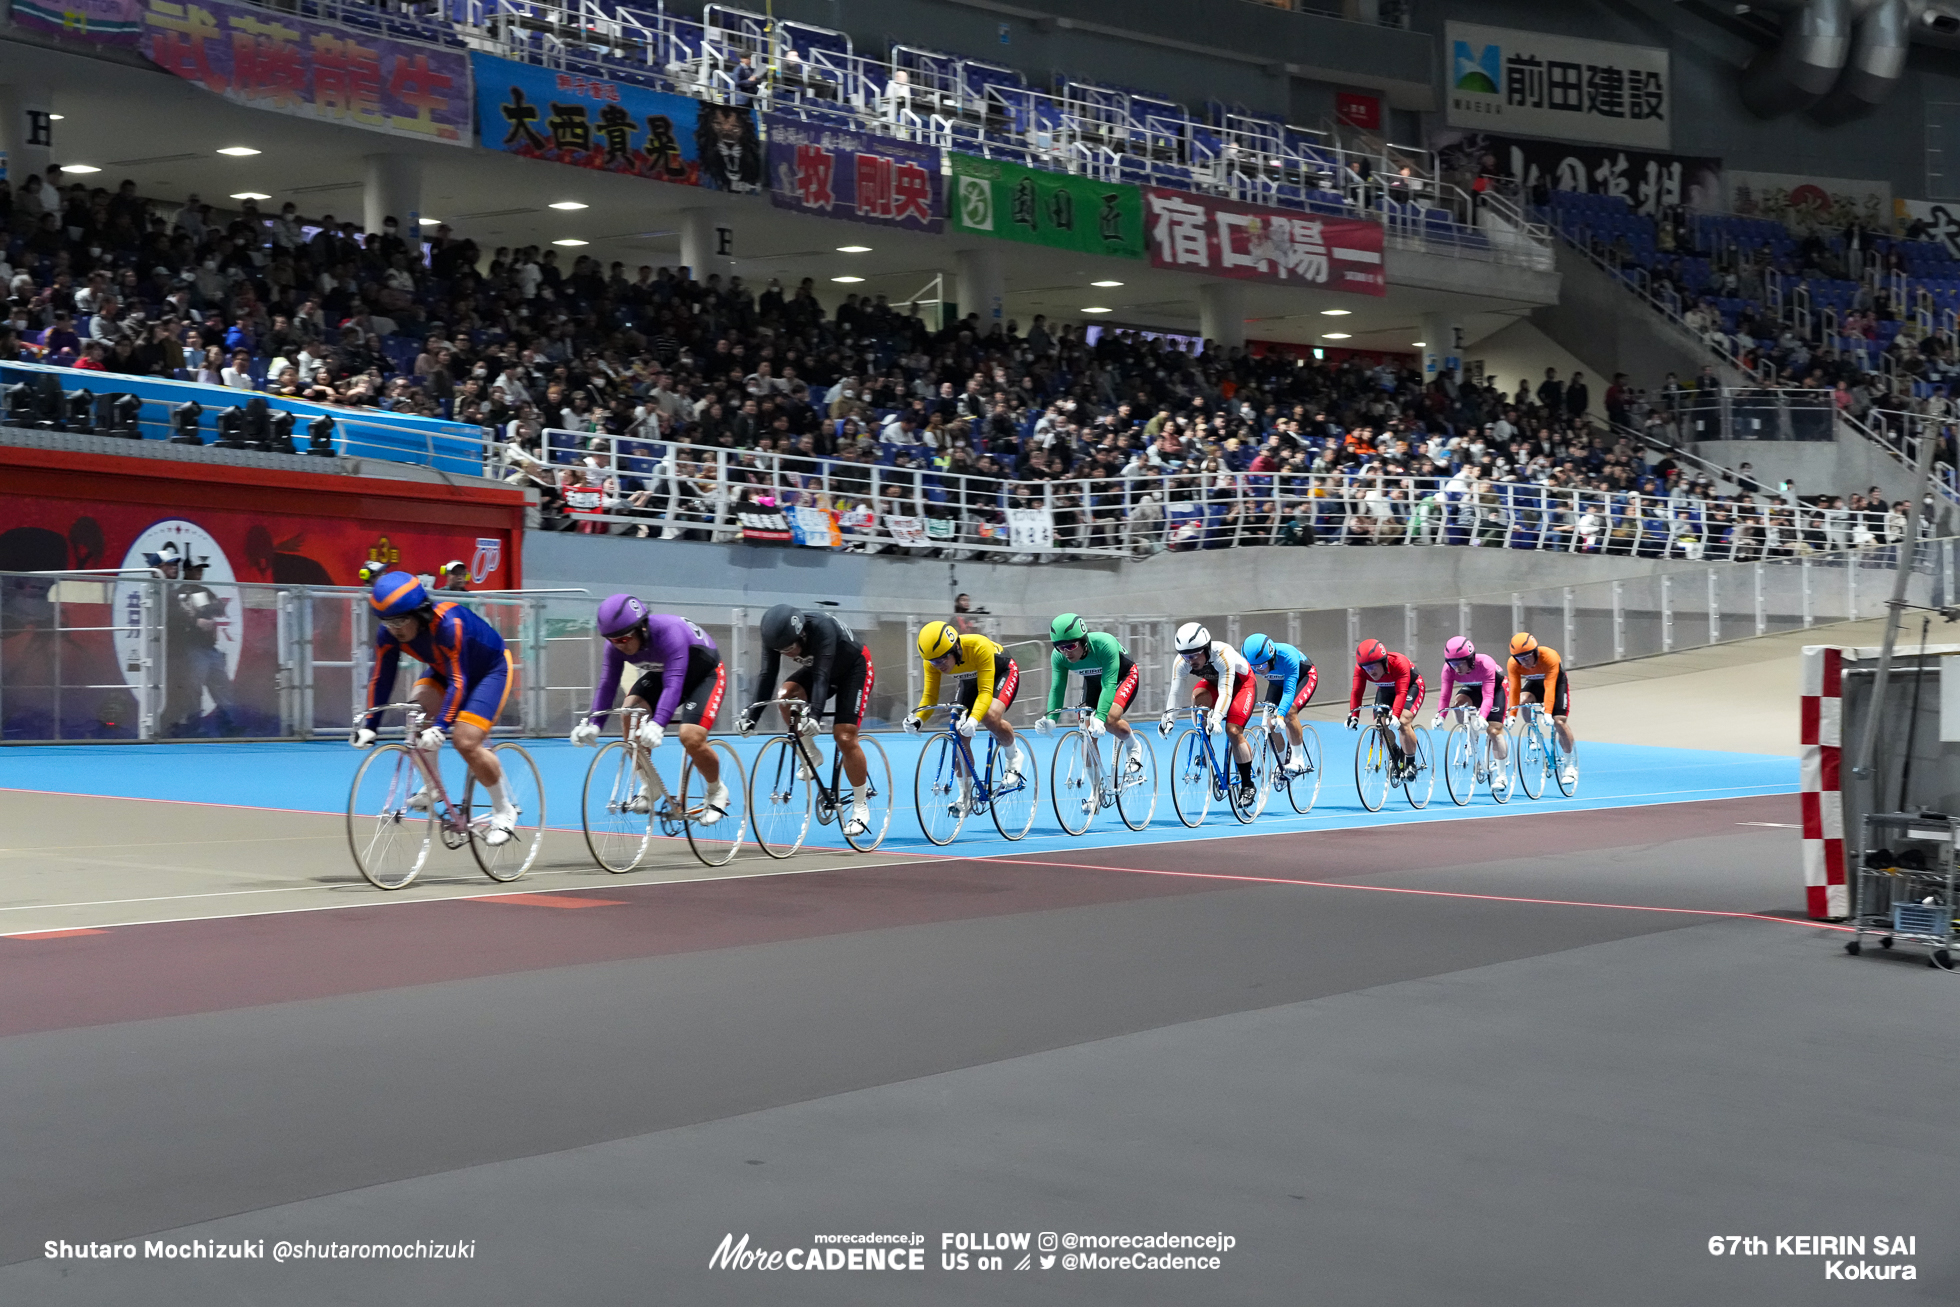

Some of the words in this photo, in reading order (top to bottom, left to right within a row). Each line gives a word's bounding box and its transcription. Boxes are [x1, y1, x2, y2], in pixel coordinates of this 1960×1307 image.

[146, 2, 455, 135] 武藤龍生
[1506, 53, 1664, 121] 前田建設
[502, 85, 690, 178] 大西貴晃
[629, 599, 643, 618] 9
[790, 616, 803, 635] 2
[945, 628, 955, 642] 5
[1079, 619, 1086, 633] 6
